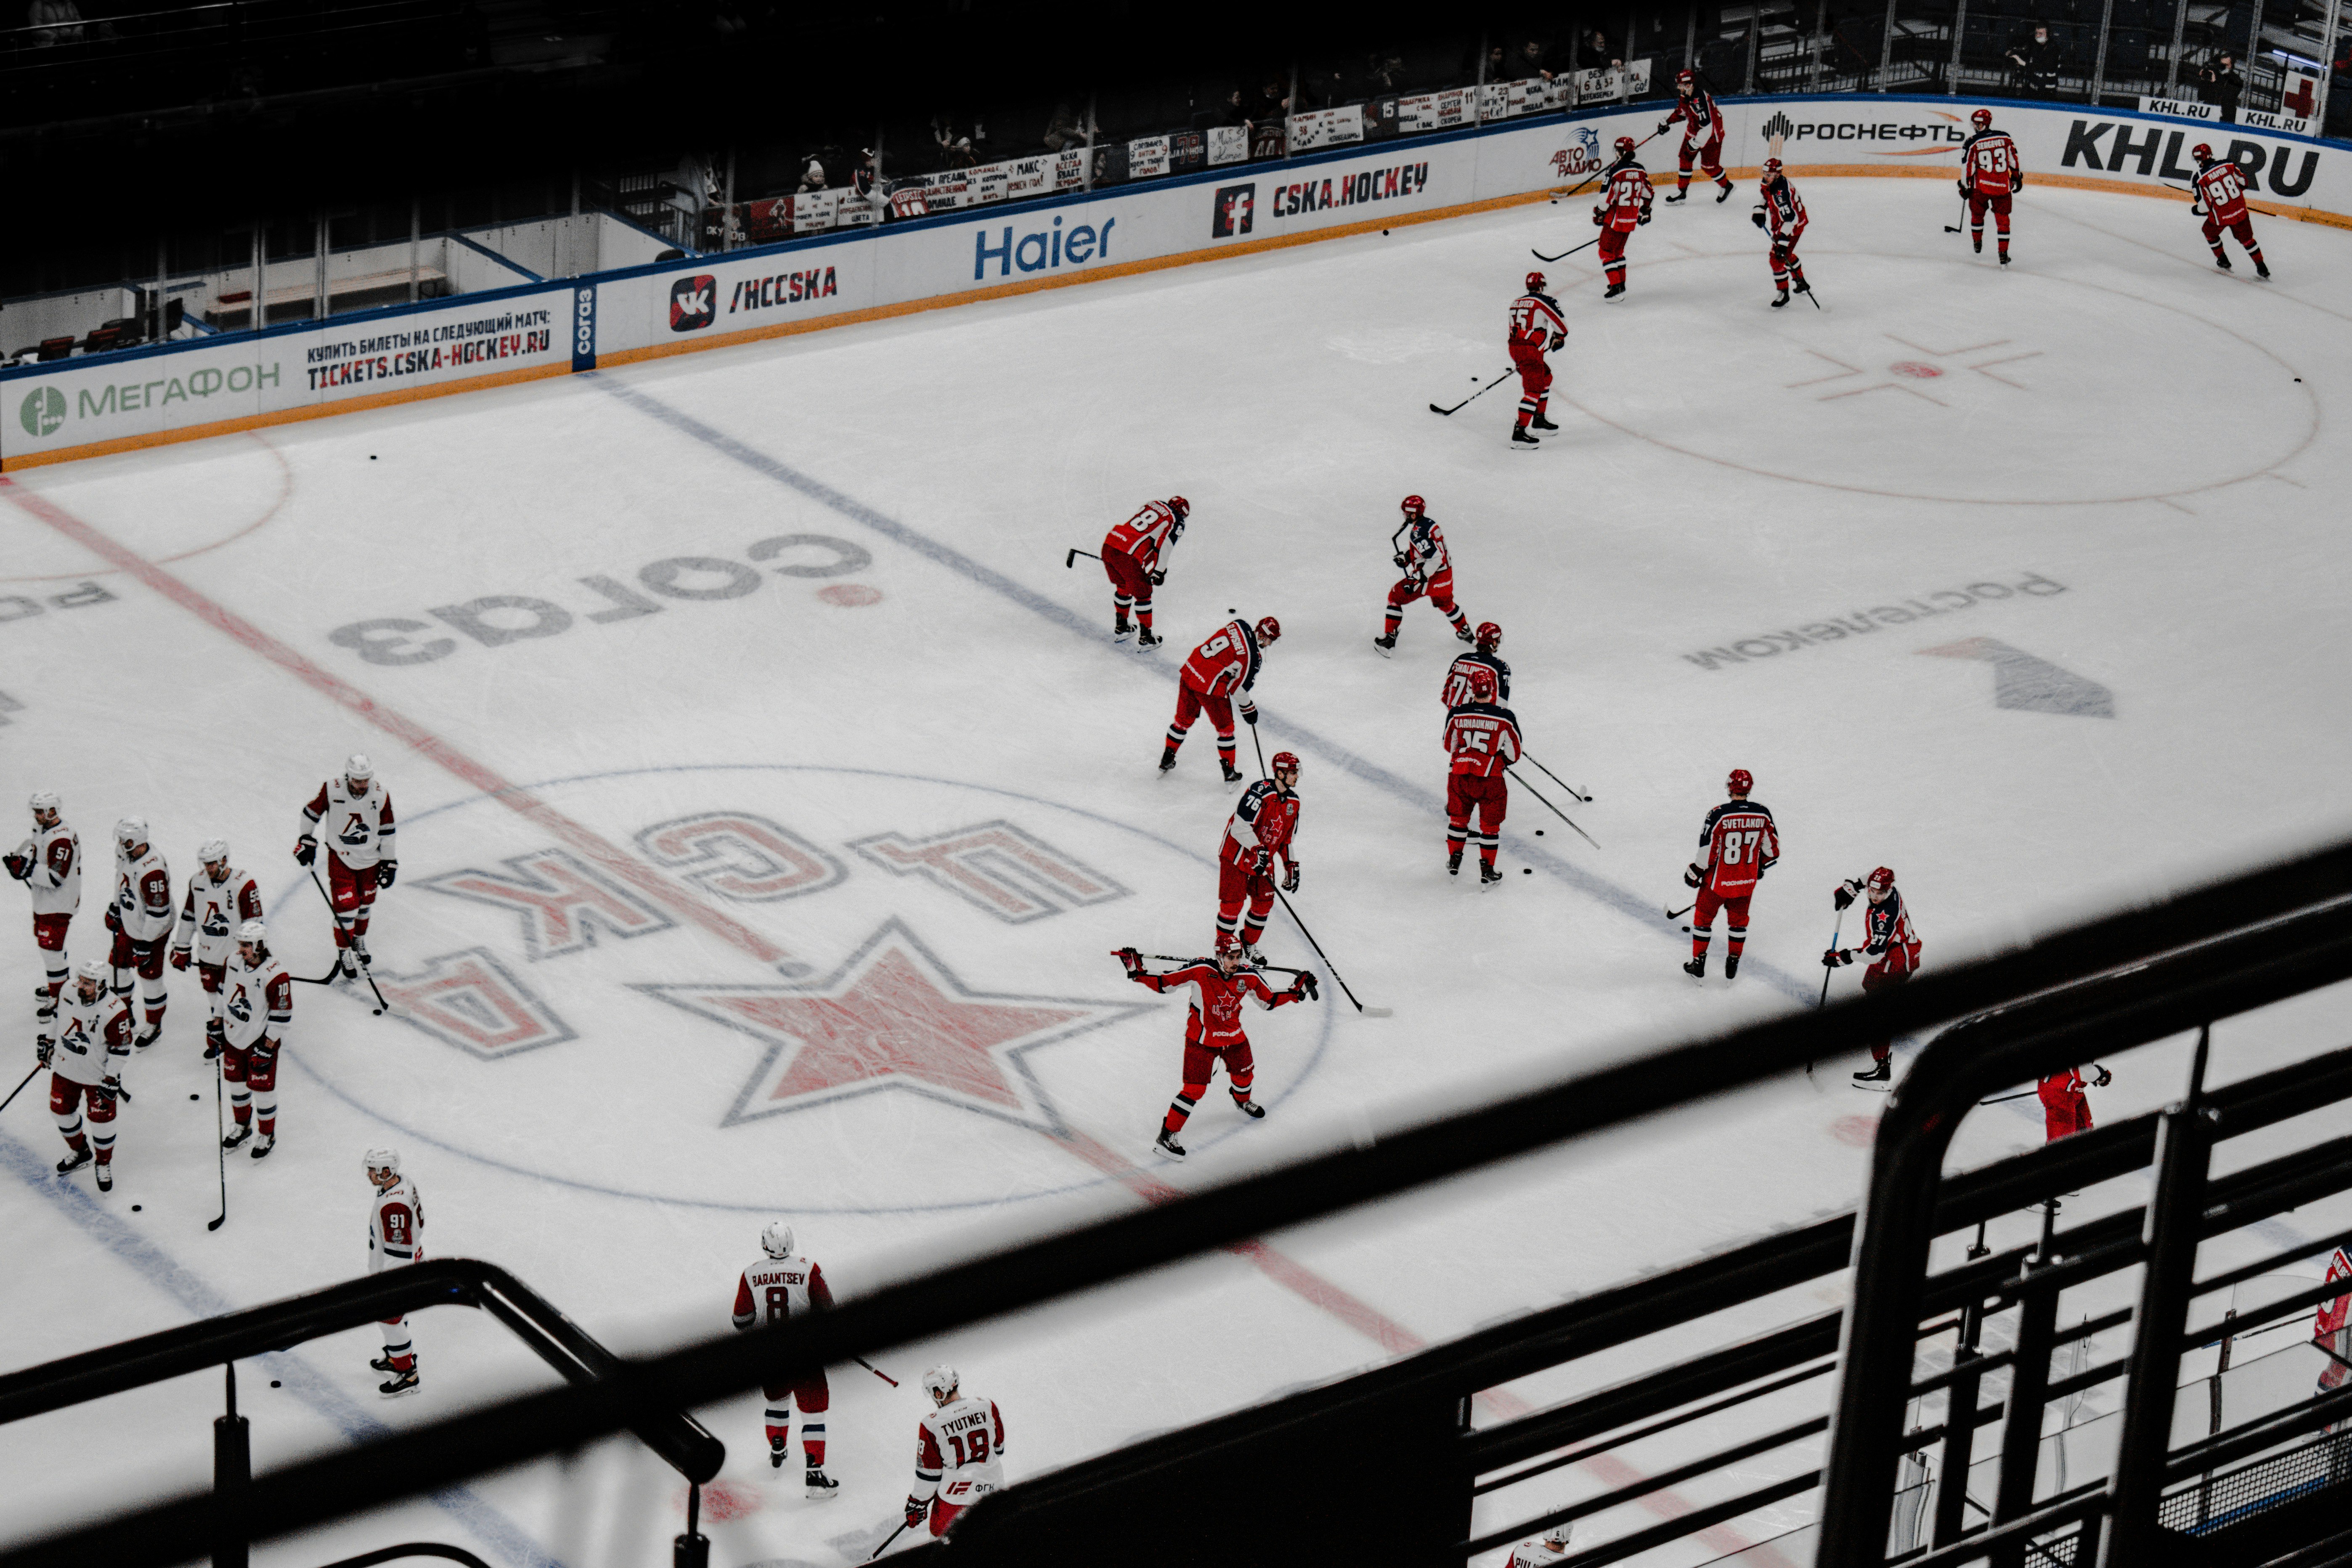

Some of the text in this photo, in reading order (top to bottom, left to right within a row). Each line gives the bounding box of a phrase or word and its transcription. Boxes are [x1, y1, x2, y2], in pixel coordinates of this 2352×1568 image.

[1383, 102, 1395, 118] 15
[2148, 100, 2211, 119] KHL.RU
[2245, 112, 2307, 133] KHL.RU
[1796, 124, 1965, 142] РОСНЕФТЬ
[1976, 139, 2005, 150] SERGEYEV
[1549, 147, 1584, 166] АВТО
[1978, 148, 2007, 173] 93
[2061, 119, 2320, 197] KHLRU
[1017, 159, 1040, 175] МАКС
[1558, 158, 1602, 178] РАДИО
[2208, 167, 2228, 180] MAMIN
[1273, 161, 1428, 218] CSKA.HOCKEY
[1618, 181, 1644, 207] 23
[2209, 175, 2241, 206] 98
[927, 196, 956, 210] ОМАНДЕ
[1779, 204, 1791, 216] 75
[974, 215, 1115, 280] Haier
[729, 266, 838, 314] /HCCSKA
[308, 310, 551, 363] КУПИТЬ БИЛЕТЫ НА СЛЕДУЮЩИЙ МАТЧ:
[308, 329, 551, 391] TICKETS.CSKA-HOCKEY.RU
[78, 362, 281, 420] МЕГАФОН
[1130, 509, 1159, 532] 8
[1416, 539, 1431, 554] 22
[329, 532, 873, 668] согаз
[1680, 569, 2070, 672] Ростелеком
[1200, 635, 1230, 659] 9
[1454, 719, 1499, 731] KARNAUKHOV
[1458, 730, 1491, 753] 15
[1245, 794, 1262, 812] 76
[1722, 818, 1765, 829] SVETLAKOV
[56, 846, 69, 861] 51
[1724, 830, 1761, 865] 87
[1871, 934, 1886, 946] 27
[278, 982, 289, 997] 10
[390, 1214, 405, 1229] 91
[752, 1272, 805, 1287] BARANTSEV
[766, 1286, 789, 1325] 8
[941, 1411, 987, 1437] TYUTNEV
[947, 1428, 989, 1470] 18
[975, 1483, 995, 1493] ФГК
